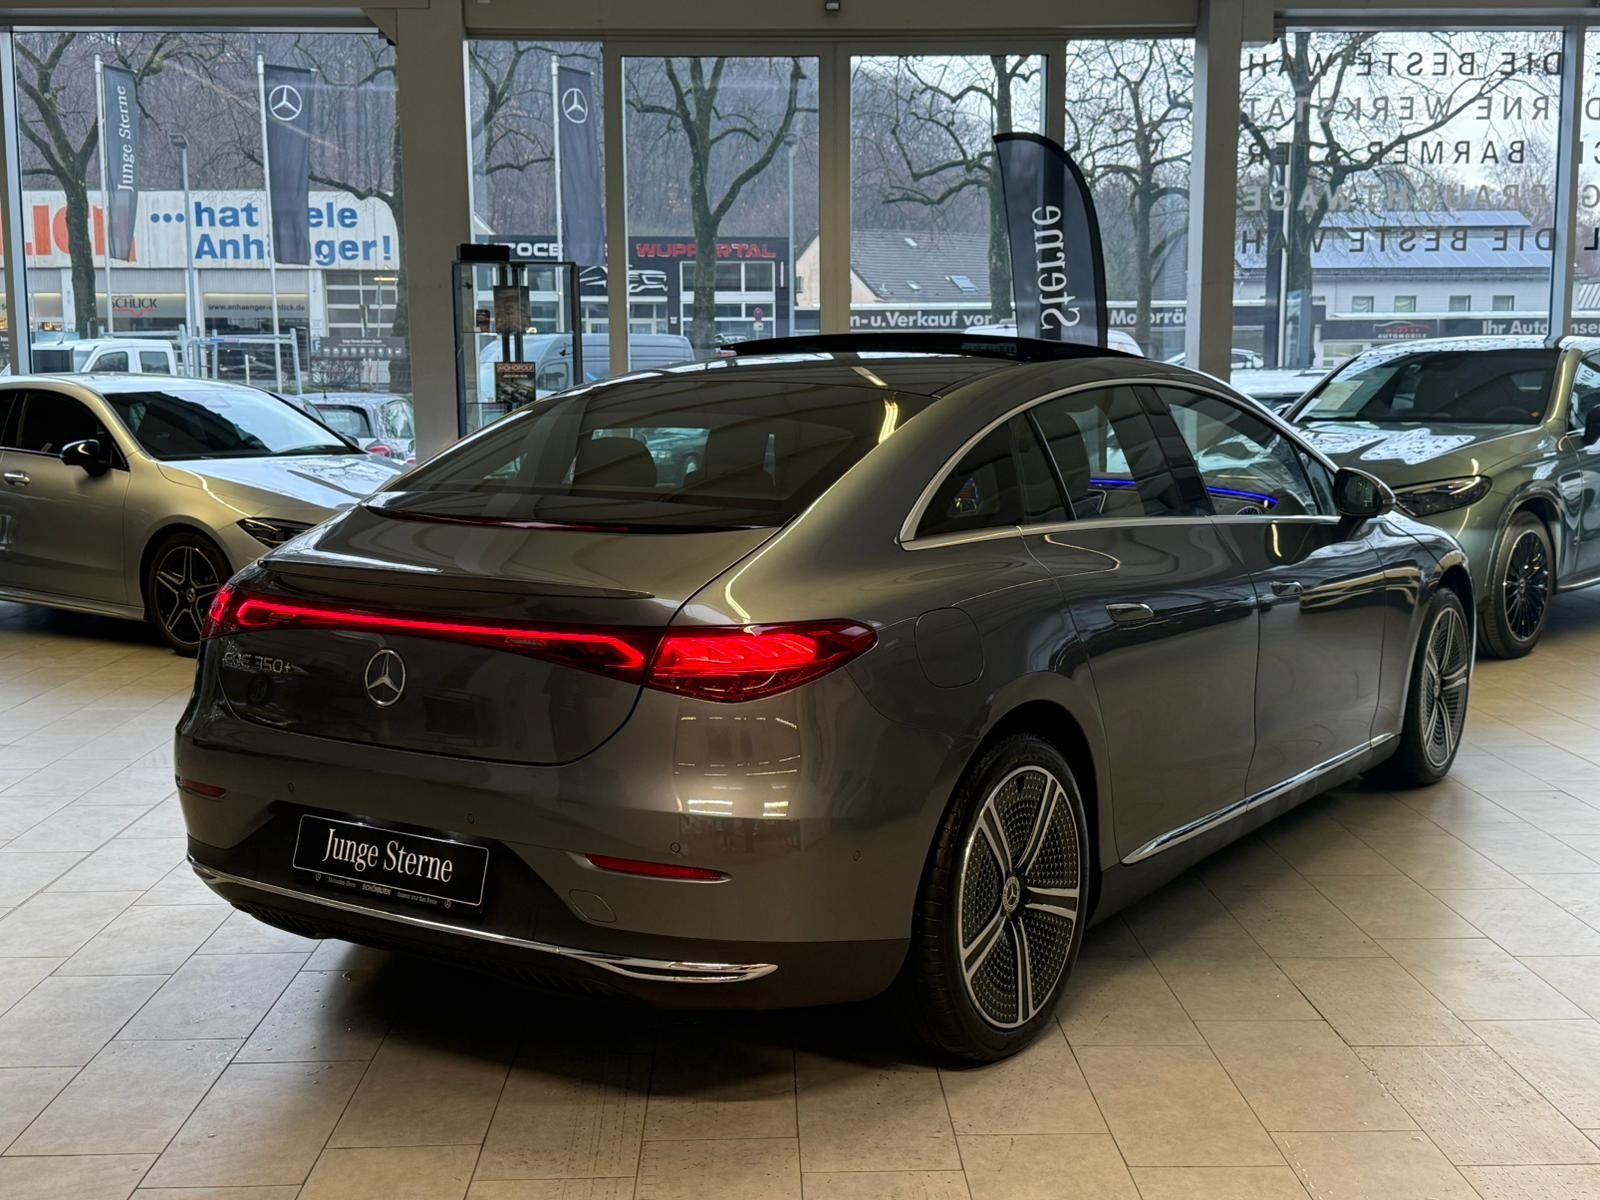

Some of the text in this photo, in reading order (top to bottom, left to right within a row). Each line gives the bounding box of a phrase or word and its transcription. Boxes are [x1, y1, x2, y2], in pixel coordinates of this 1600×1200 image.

[116, 85, 135, 192] Junge Sterne
[308, 202, 358, 228] ele
[194, 233, 392, 266] Anhger!
[635, 243, 777, 258] WUPPRTAL
[207, 303, 305, 313] www.anhaenger-shlick.de
[1110, 308, 1184, 325] Morrä
[1482, 319, 1506, 335] Ihr
[321, 828, 453, 883] Junge Sterne
